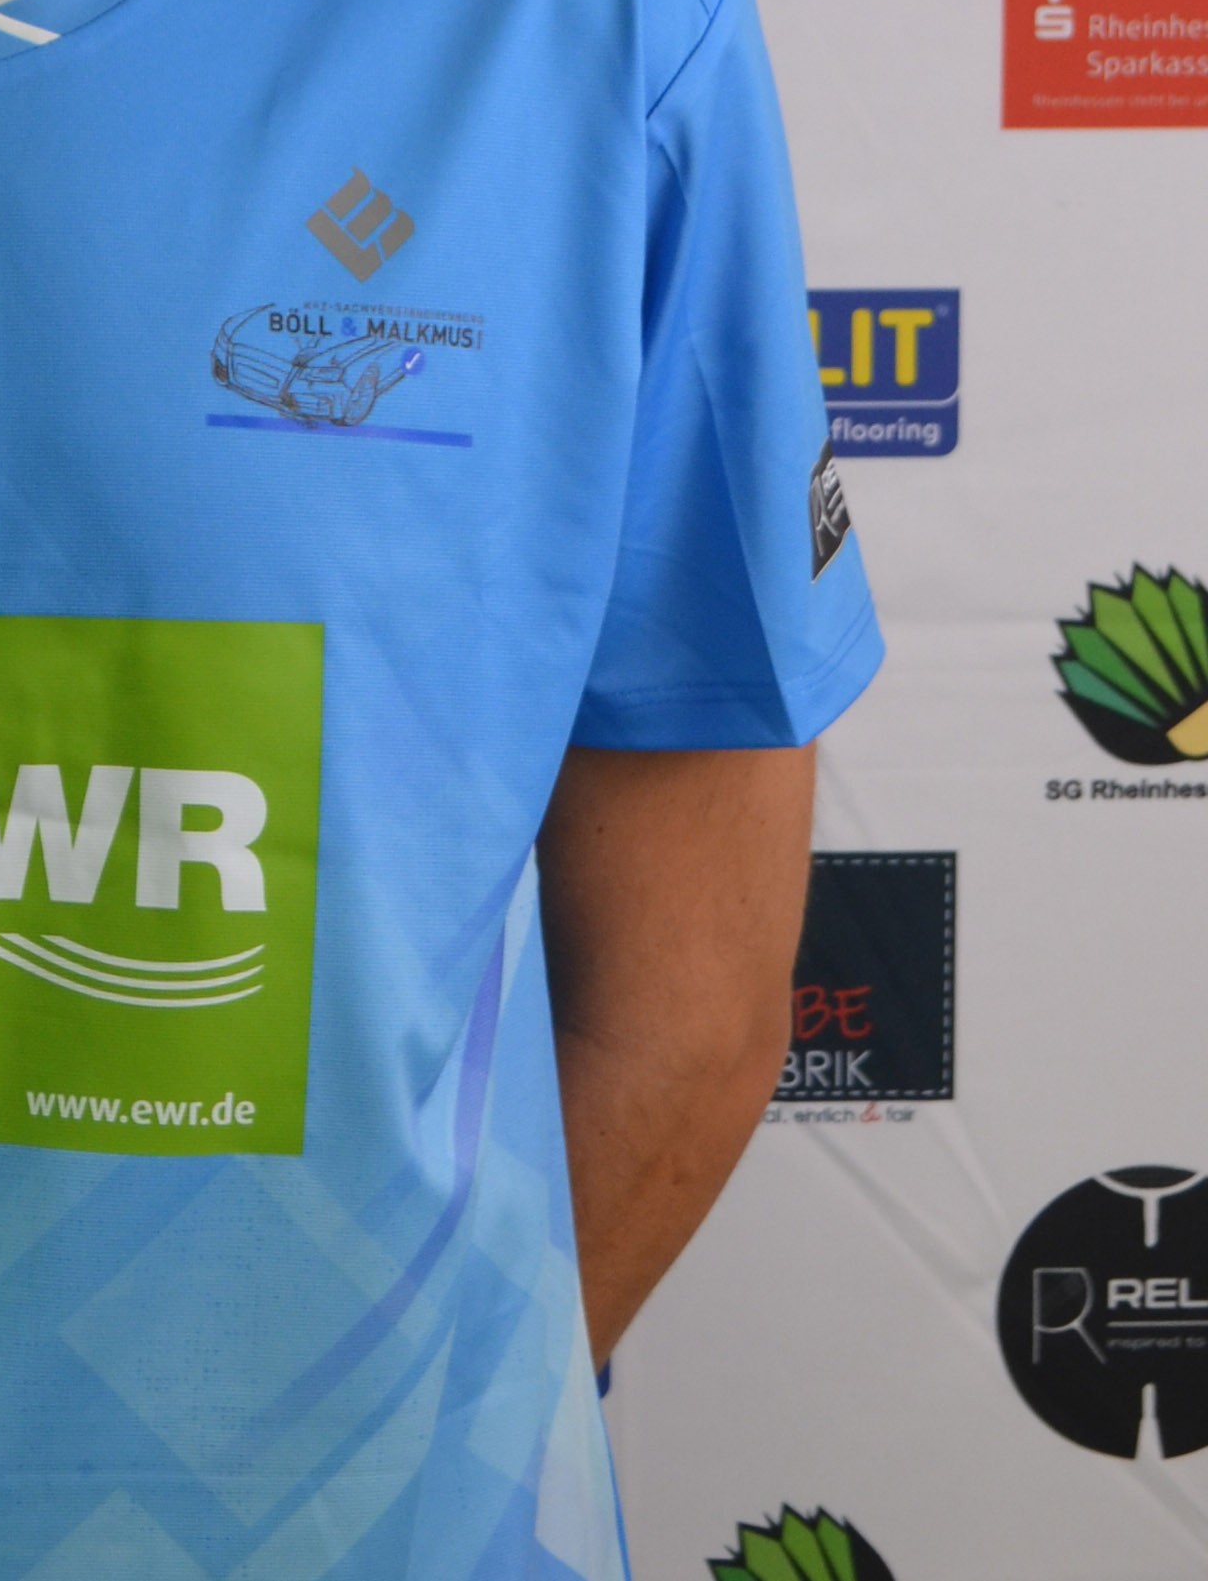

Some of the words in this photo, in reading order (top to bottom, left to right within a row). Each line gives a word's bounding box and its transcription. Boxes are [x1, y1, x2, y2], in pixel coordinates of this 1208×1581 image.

[268, 308, 332, 337] BÖLL
[341, 317, 358, 337] &
[366, 318, 473, 349] MALKMUS
[830, 417, 941, 447] flooring
[1045, 779, 1082, 801] SG
[26, 1091, 256, 1126] www.ewr.de
